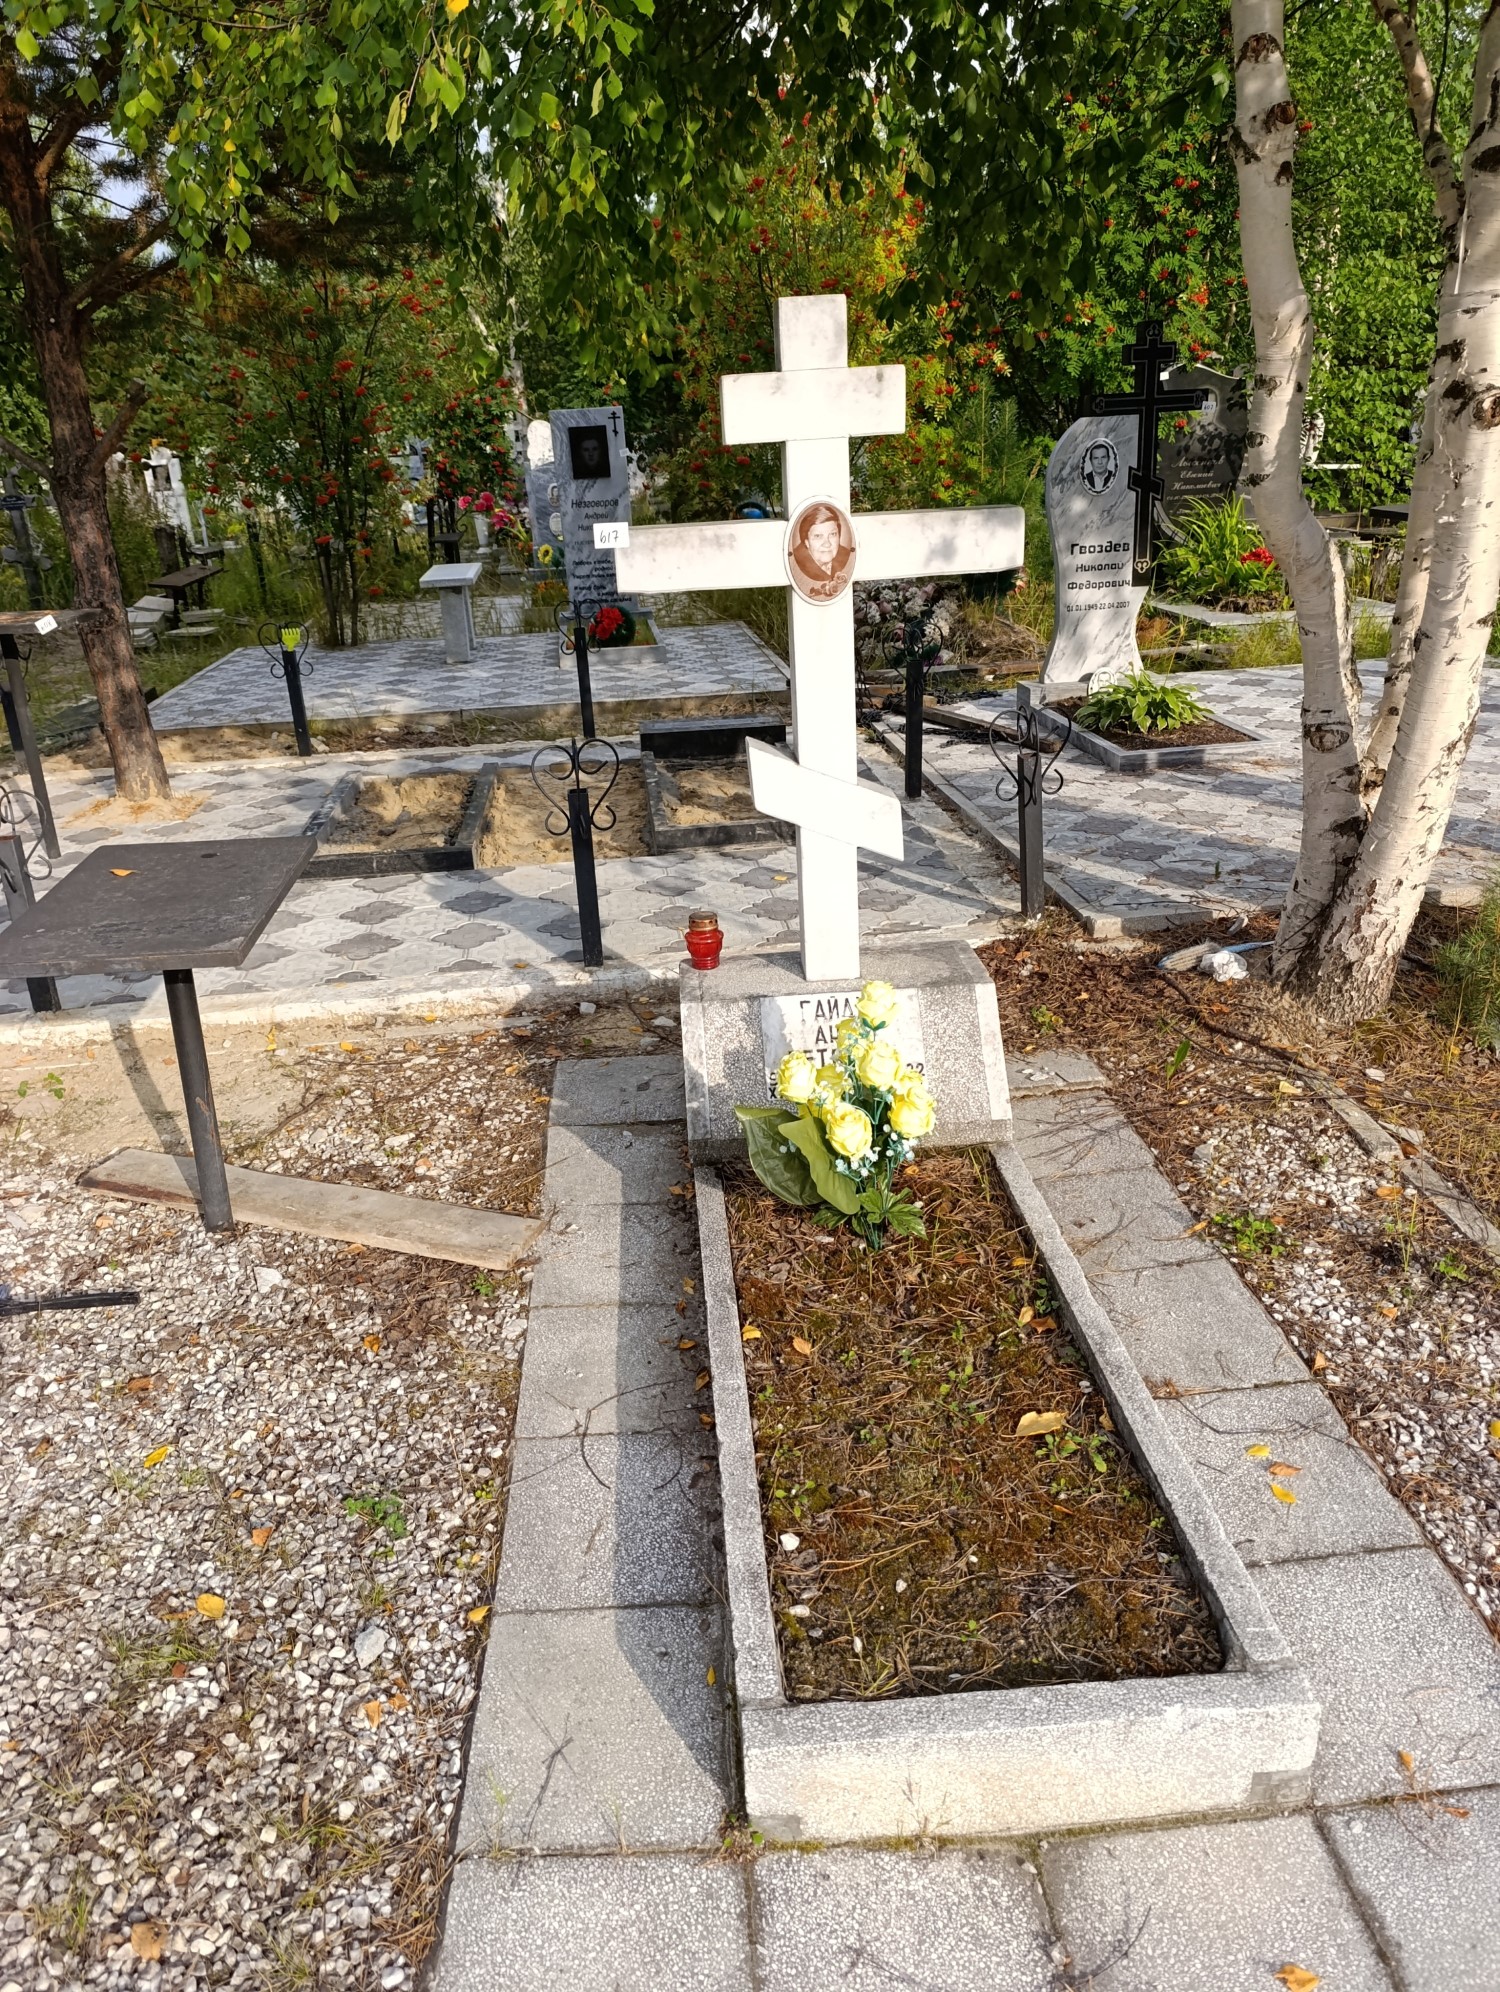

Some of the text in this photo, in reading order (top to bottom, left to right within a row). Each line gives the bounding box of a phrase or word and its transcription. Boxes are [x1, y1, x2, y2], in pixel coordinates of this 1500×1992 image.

[571, 499, 619, 509] Незговоров
[584, 512, 609, 520] Андрей
[1070, 540, 1130, 556] Гвоздев
[1075, 561, 1125, 573] Николай
[1067, 579, 1131, 591] Федорович
